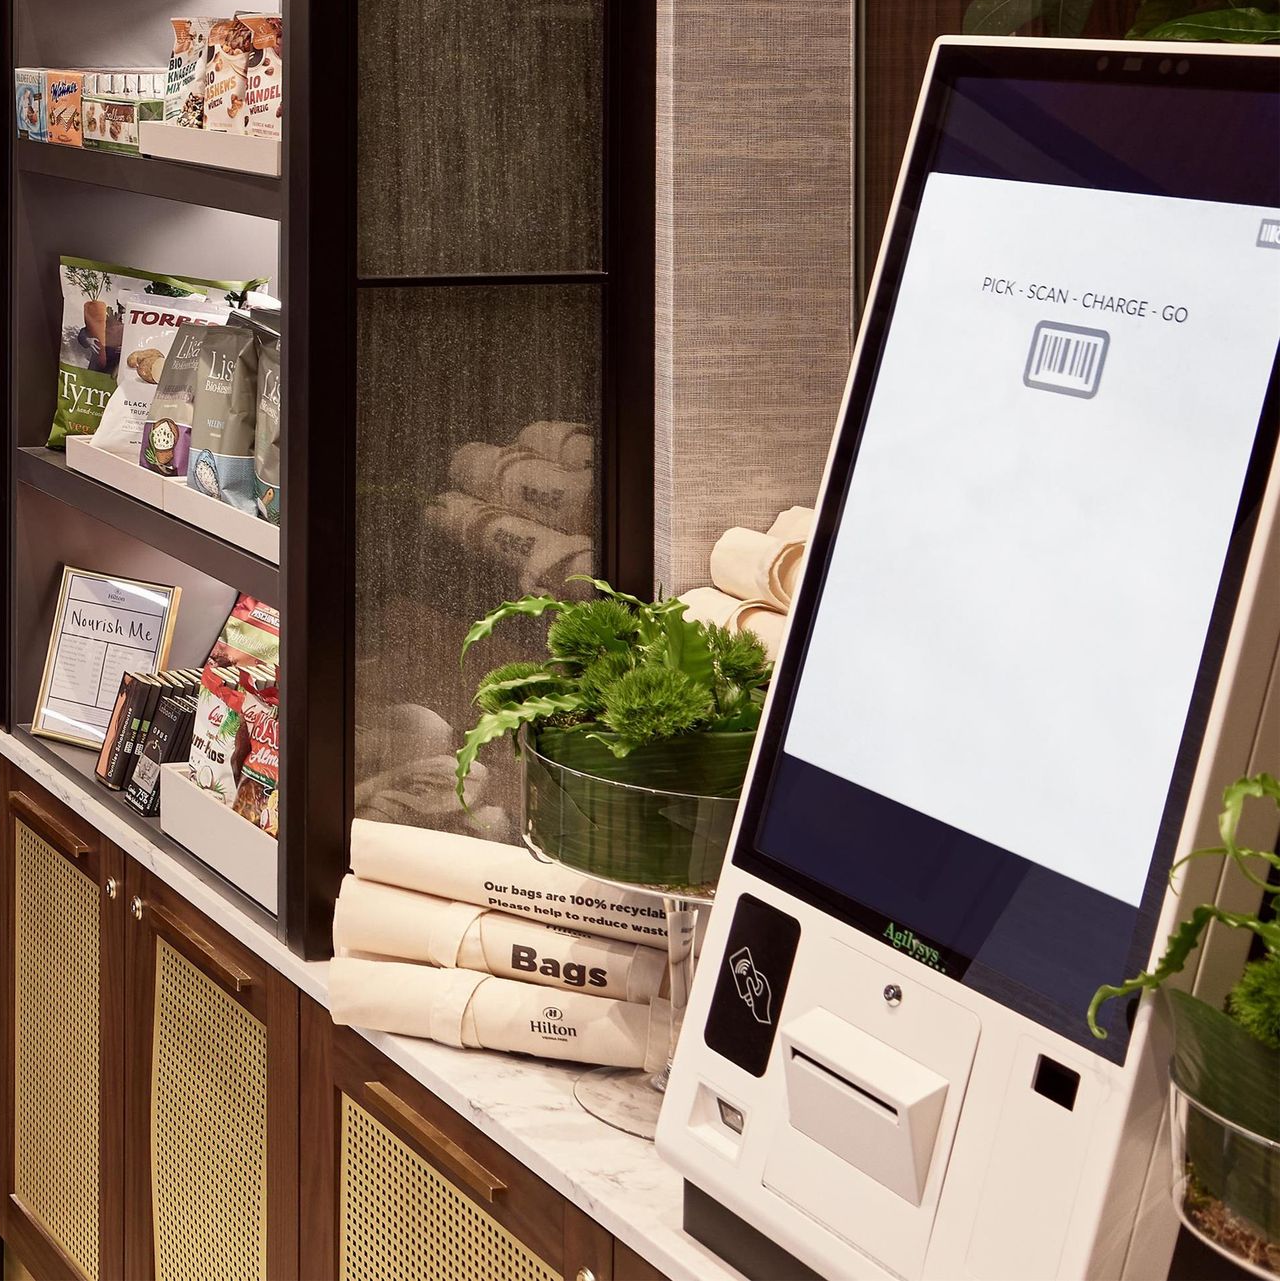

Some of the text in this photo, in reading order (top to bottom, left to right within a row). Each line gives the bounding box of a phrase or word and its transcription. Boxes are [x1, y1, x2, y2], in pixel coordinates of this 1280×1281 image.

[169, 57, 182, 70] BIO
[166, 81, 180, 95] MIX
[982, 276, 1189, 324] PICK SCAN CHARGE GO
[60, 370, 111, 413] Tyrr
[124, 400, 147, 408] BLACK
[71, 609, 153, 641] Nourish Me
[153, 726, 168, 742] OPUS
[484, 881, 668, 920] Our bags are 100% recyclab
[488, 897, 531, 912] Please
[534, 902, 562, 919] help
[565, 910, 580, 921] to
[583, 914, 628, 930] reduce
[883, 922, 940, 963] Agilysys
[511, 943, 608, 988] Bags
[530, 1020, 577, 1037] Hilton
